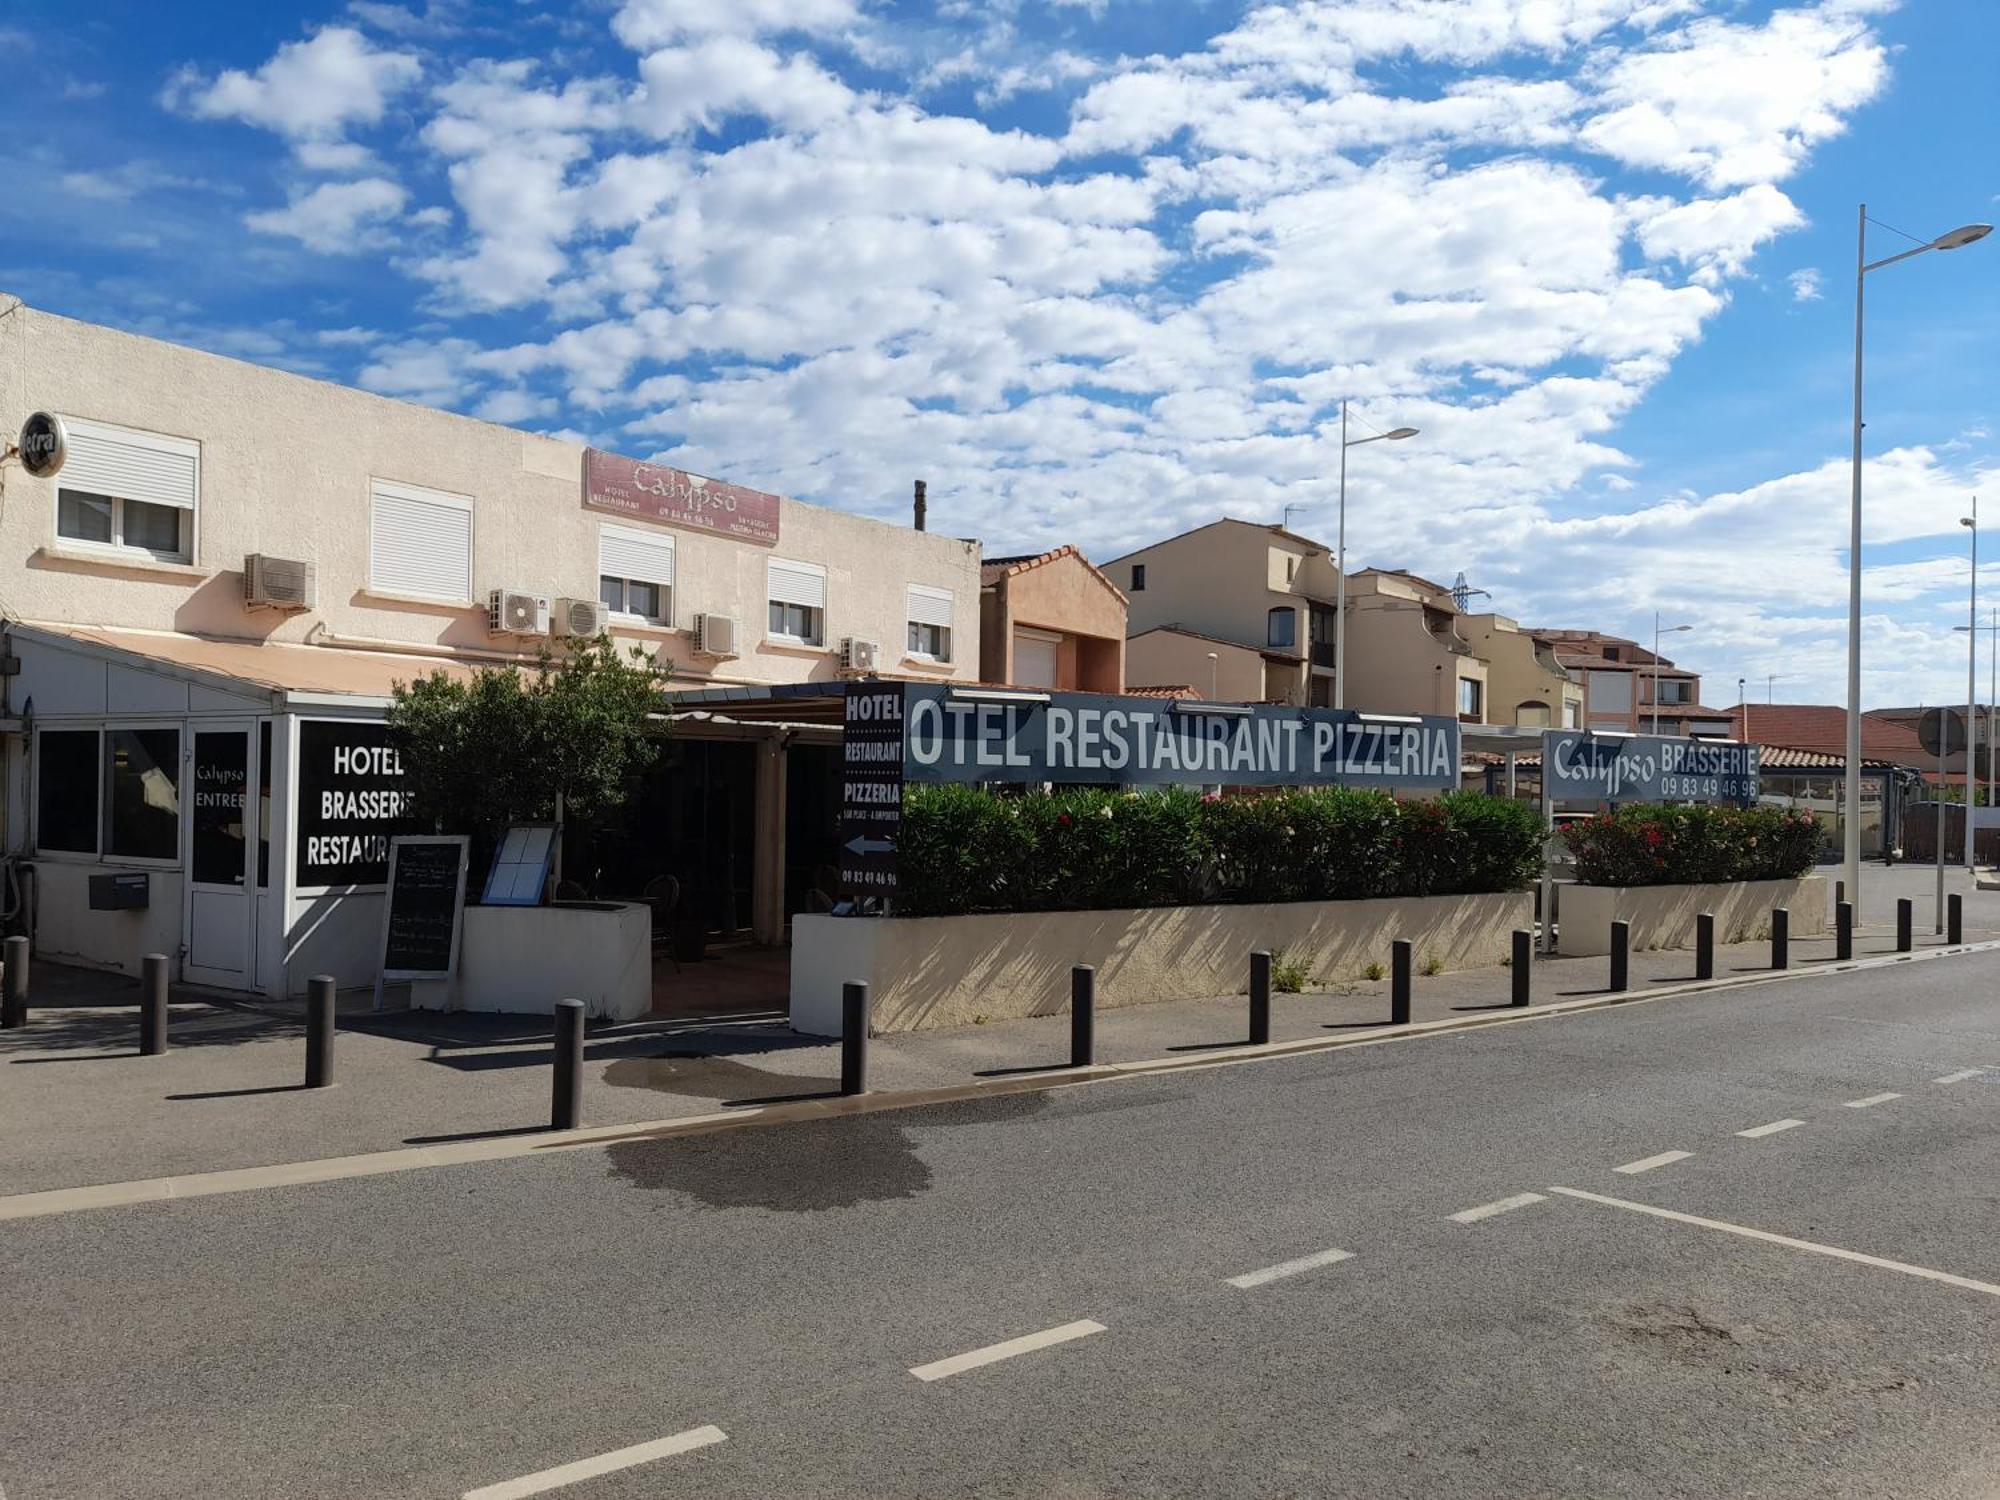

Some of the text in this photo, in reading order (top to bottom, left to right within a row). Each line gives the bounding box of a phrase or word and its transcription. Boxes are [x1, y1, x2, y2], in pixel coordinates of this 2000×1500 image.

[634, 464, 737, 513] Calypso
[845, 694, 902, 721] HOTEL
[904, 698, 1452, 778] OTEL RESTAURANT PIZZERIA
[334, 745, 405, 776] HOTEL
[845, 742, 901, 763] RESTAURANT
[1553, 736, 1656, 796] Calypso
[1661, 743, 1757, 776] BRASSERIE
[196, 764, 245, 785] Calypso
[1661, 777, 1757, 798] 09 83 49 46 96
[195, 792, 247, 808] ENTREE
[844, 783, 900, 804] PIZZERIA
[307, 835, 388, 865] RESTAUR
[842, 870, 852, 882] 09
[887, 873, 897, 886] 96
